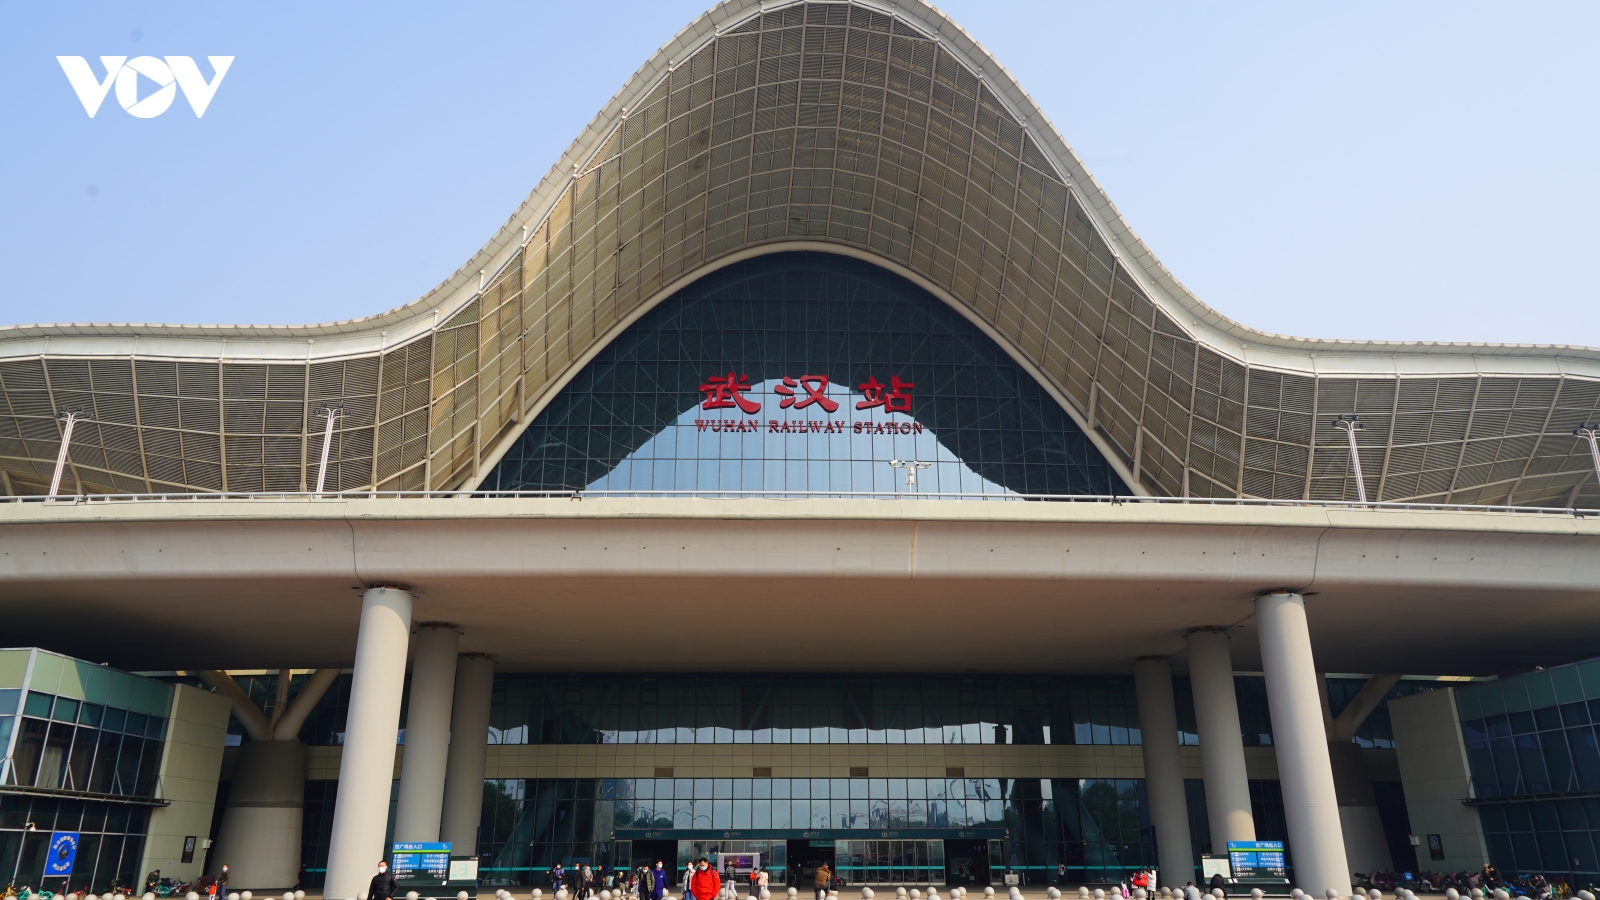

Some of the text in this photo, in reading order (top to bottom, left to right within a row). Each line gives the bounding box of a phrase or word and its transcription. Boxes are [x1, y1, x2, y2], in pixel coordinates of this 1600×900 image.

[699, 372, 914, 414] 武汉站
[695, 419, 923, 435] WUHAN RAILWAY STATION
